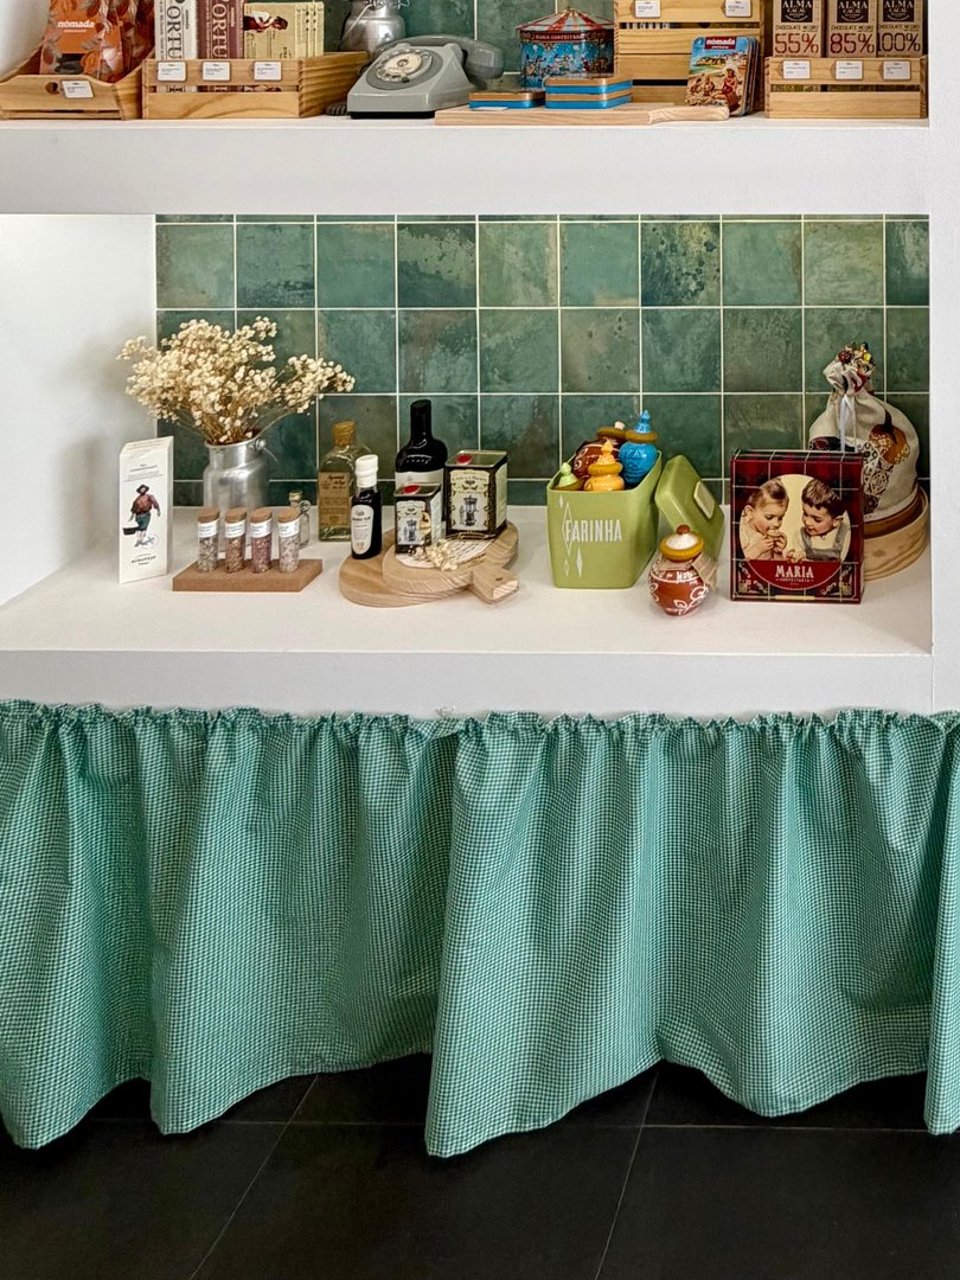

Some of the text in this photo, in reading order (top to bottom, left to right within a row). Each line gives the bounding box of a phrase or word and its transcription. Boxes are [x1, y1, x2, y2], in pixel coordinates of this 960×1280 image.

[782, 0, 812, 8] ALMA
[838, 1, 868, 9] ALMA
[884, 0, 913, 8] ALMA
[775, 33, 819, 53] 55%
[830, 33, 875, 53] 85%
[565, 519, 622, 542] FARINHA
[775, 565, 815, 578] MARIA
